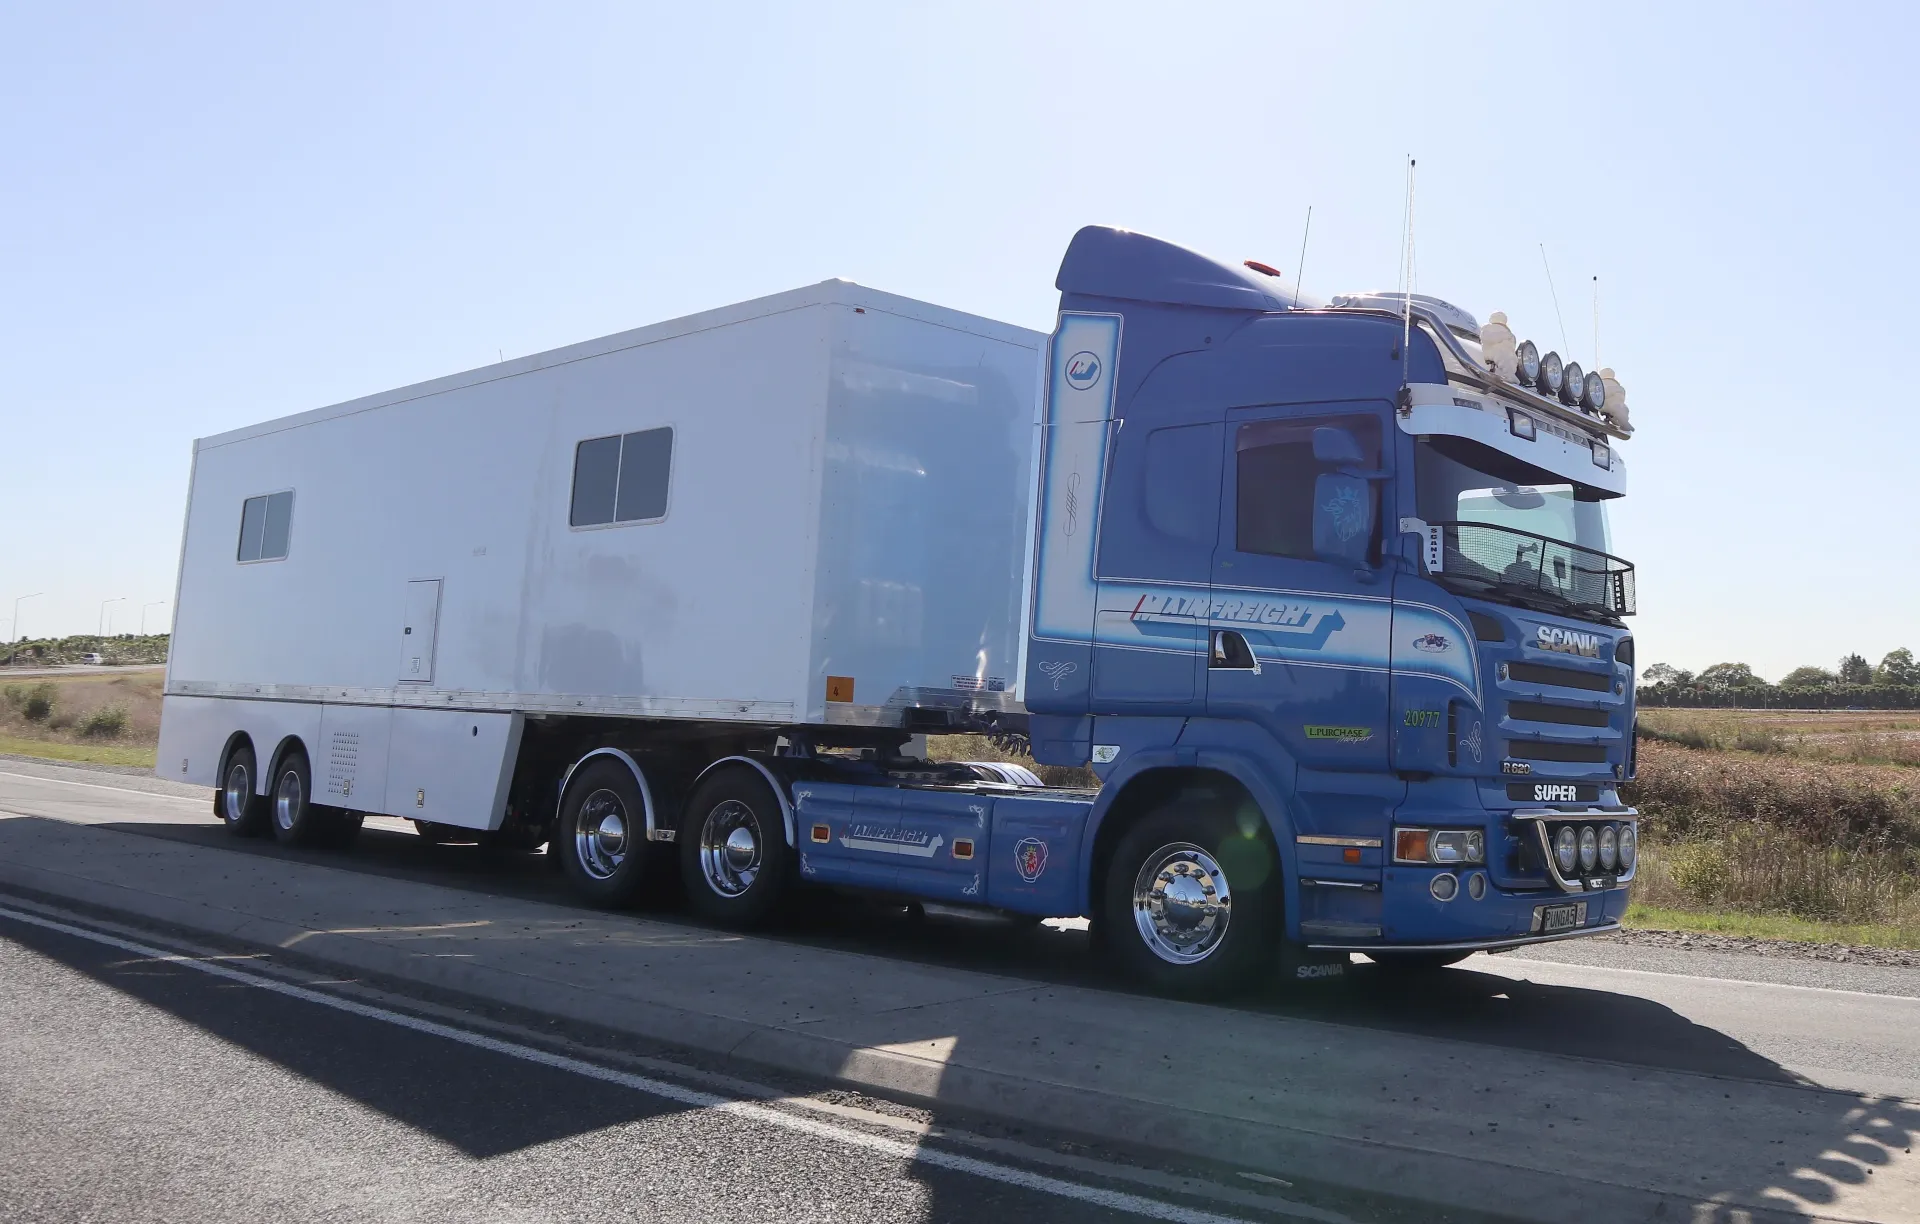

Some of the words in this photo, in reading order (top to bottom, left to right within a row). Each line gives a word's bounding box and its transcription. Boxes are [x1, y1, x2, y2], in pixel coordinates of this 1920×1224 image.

[1429, 527, 1438, 565] SCANIA
[1130, 594, 1334, 634] MAINFREIGHT
[1536, 626, 1601, 658] SCANIA
[1404, 710, 1441, 728] 20977
[1511, 763, 1531, 775] 620
[1533, 784, 1577, 802] SUPER
[1296, 964, 1344, 978] SCANIA
